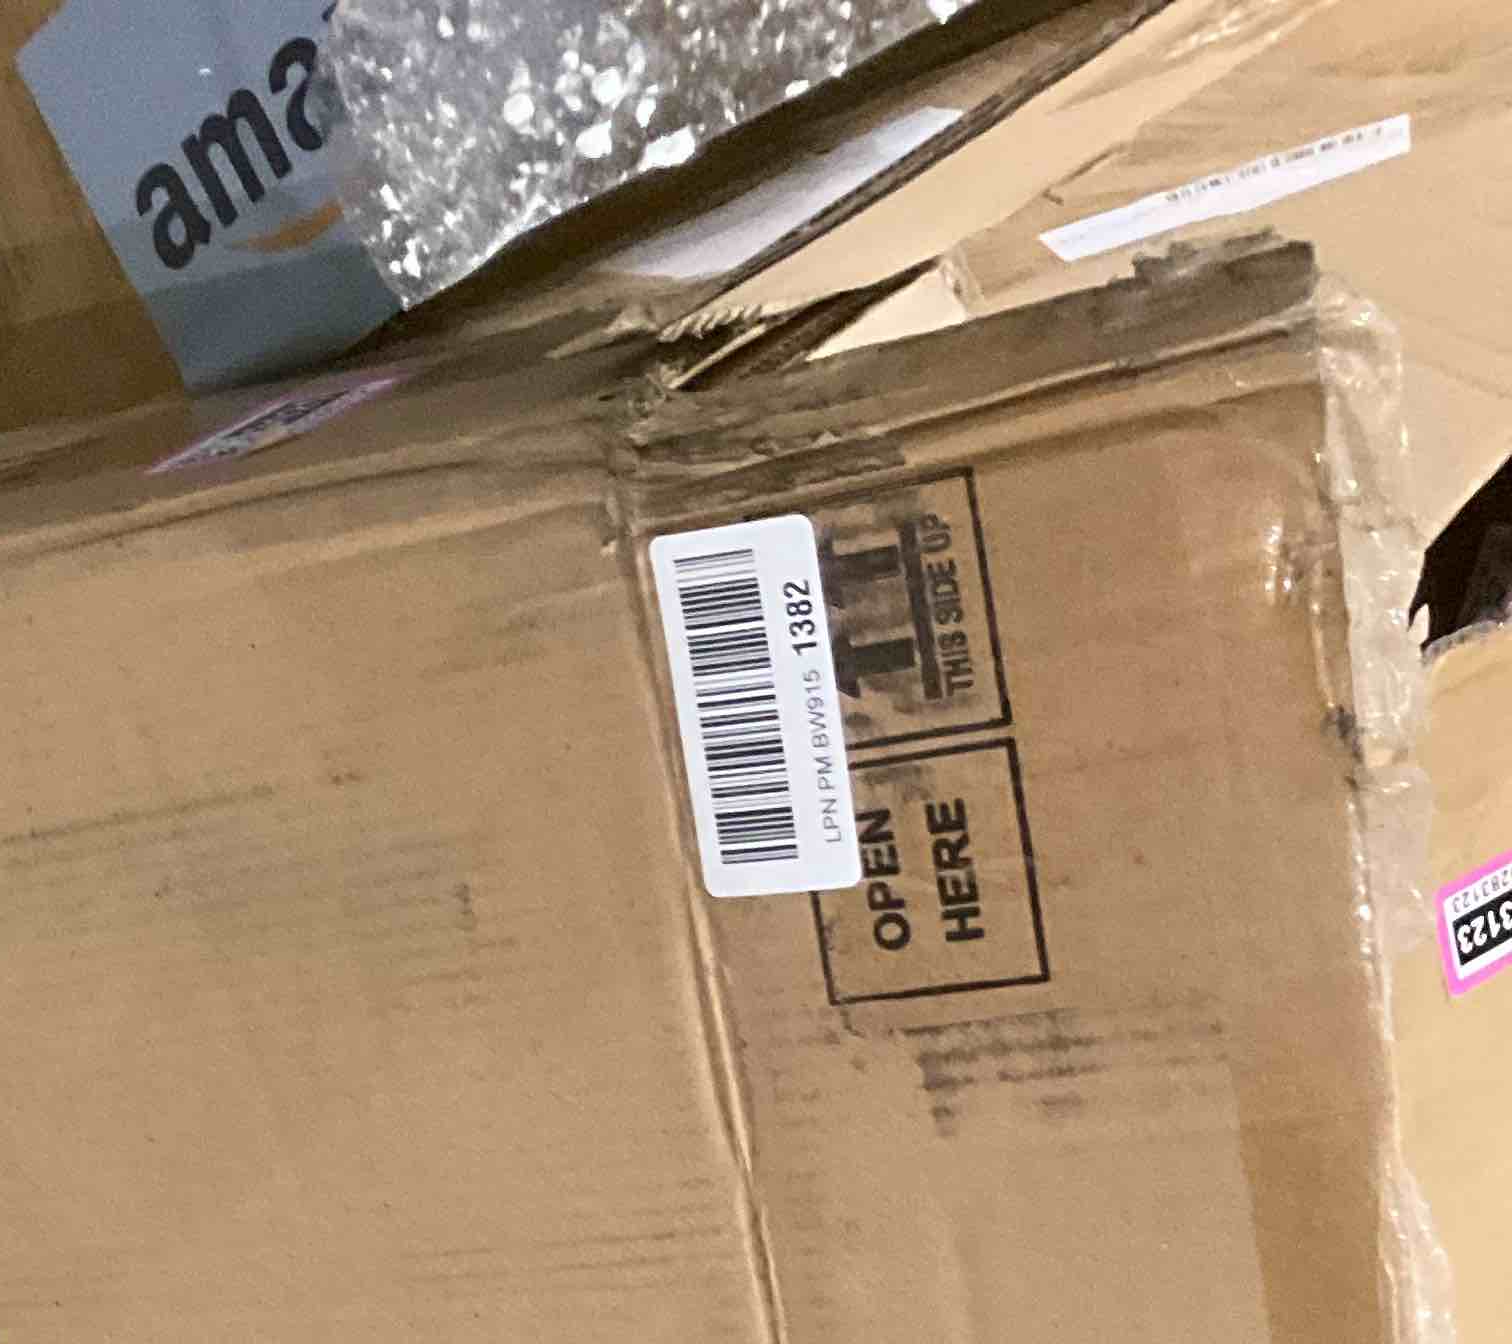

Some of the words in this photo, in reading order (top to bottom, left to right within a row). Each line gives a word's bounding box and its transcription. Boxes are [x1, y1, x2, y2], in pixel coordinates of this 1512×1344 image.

[135, 2, 338, 270] ama
[921, 512, 953, 554] UP
[783, 579, 818, 658] 1382
[927, 558, 965, 626] SIDE
[939, 631, 975, 697] THIS
[818, 798, 842, 844] LPN
[854, 807, 911, 951] OPEN
[925, 797, 986, 943] HERE
